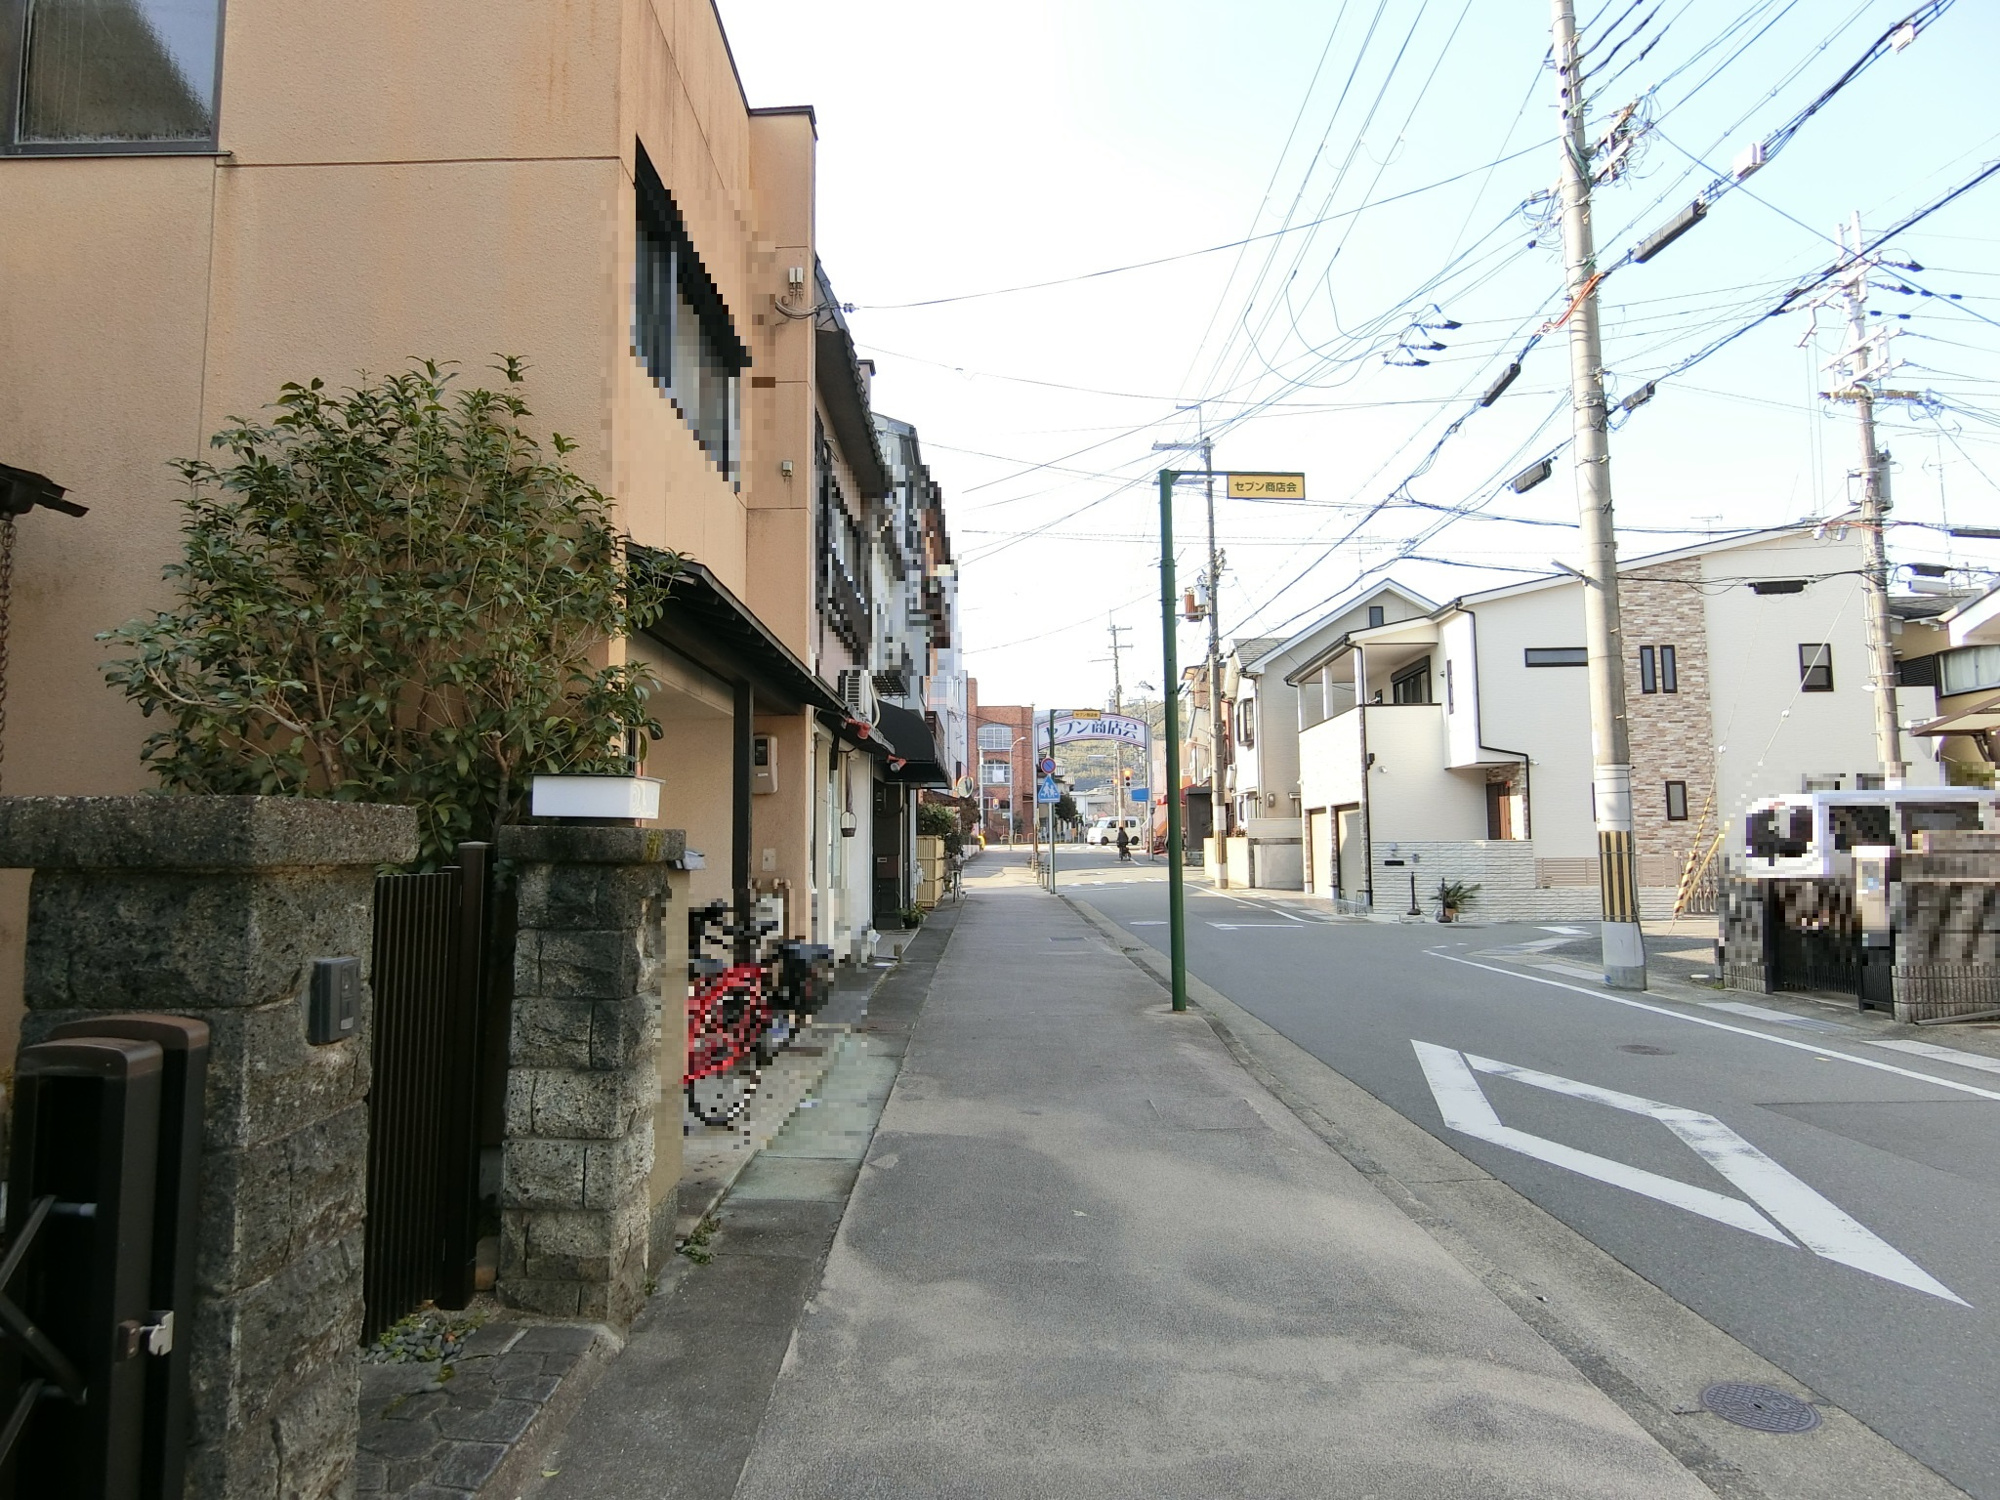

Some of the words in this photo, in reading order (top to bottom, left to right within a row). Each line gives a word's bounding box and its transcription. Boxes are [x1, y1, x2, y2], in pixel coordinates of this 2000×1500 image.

[1235, 481, 1297, 493] セブン商店会
